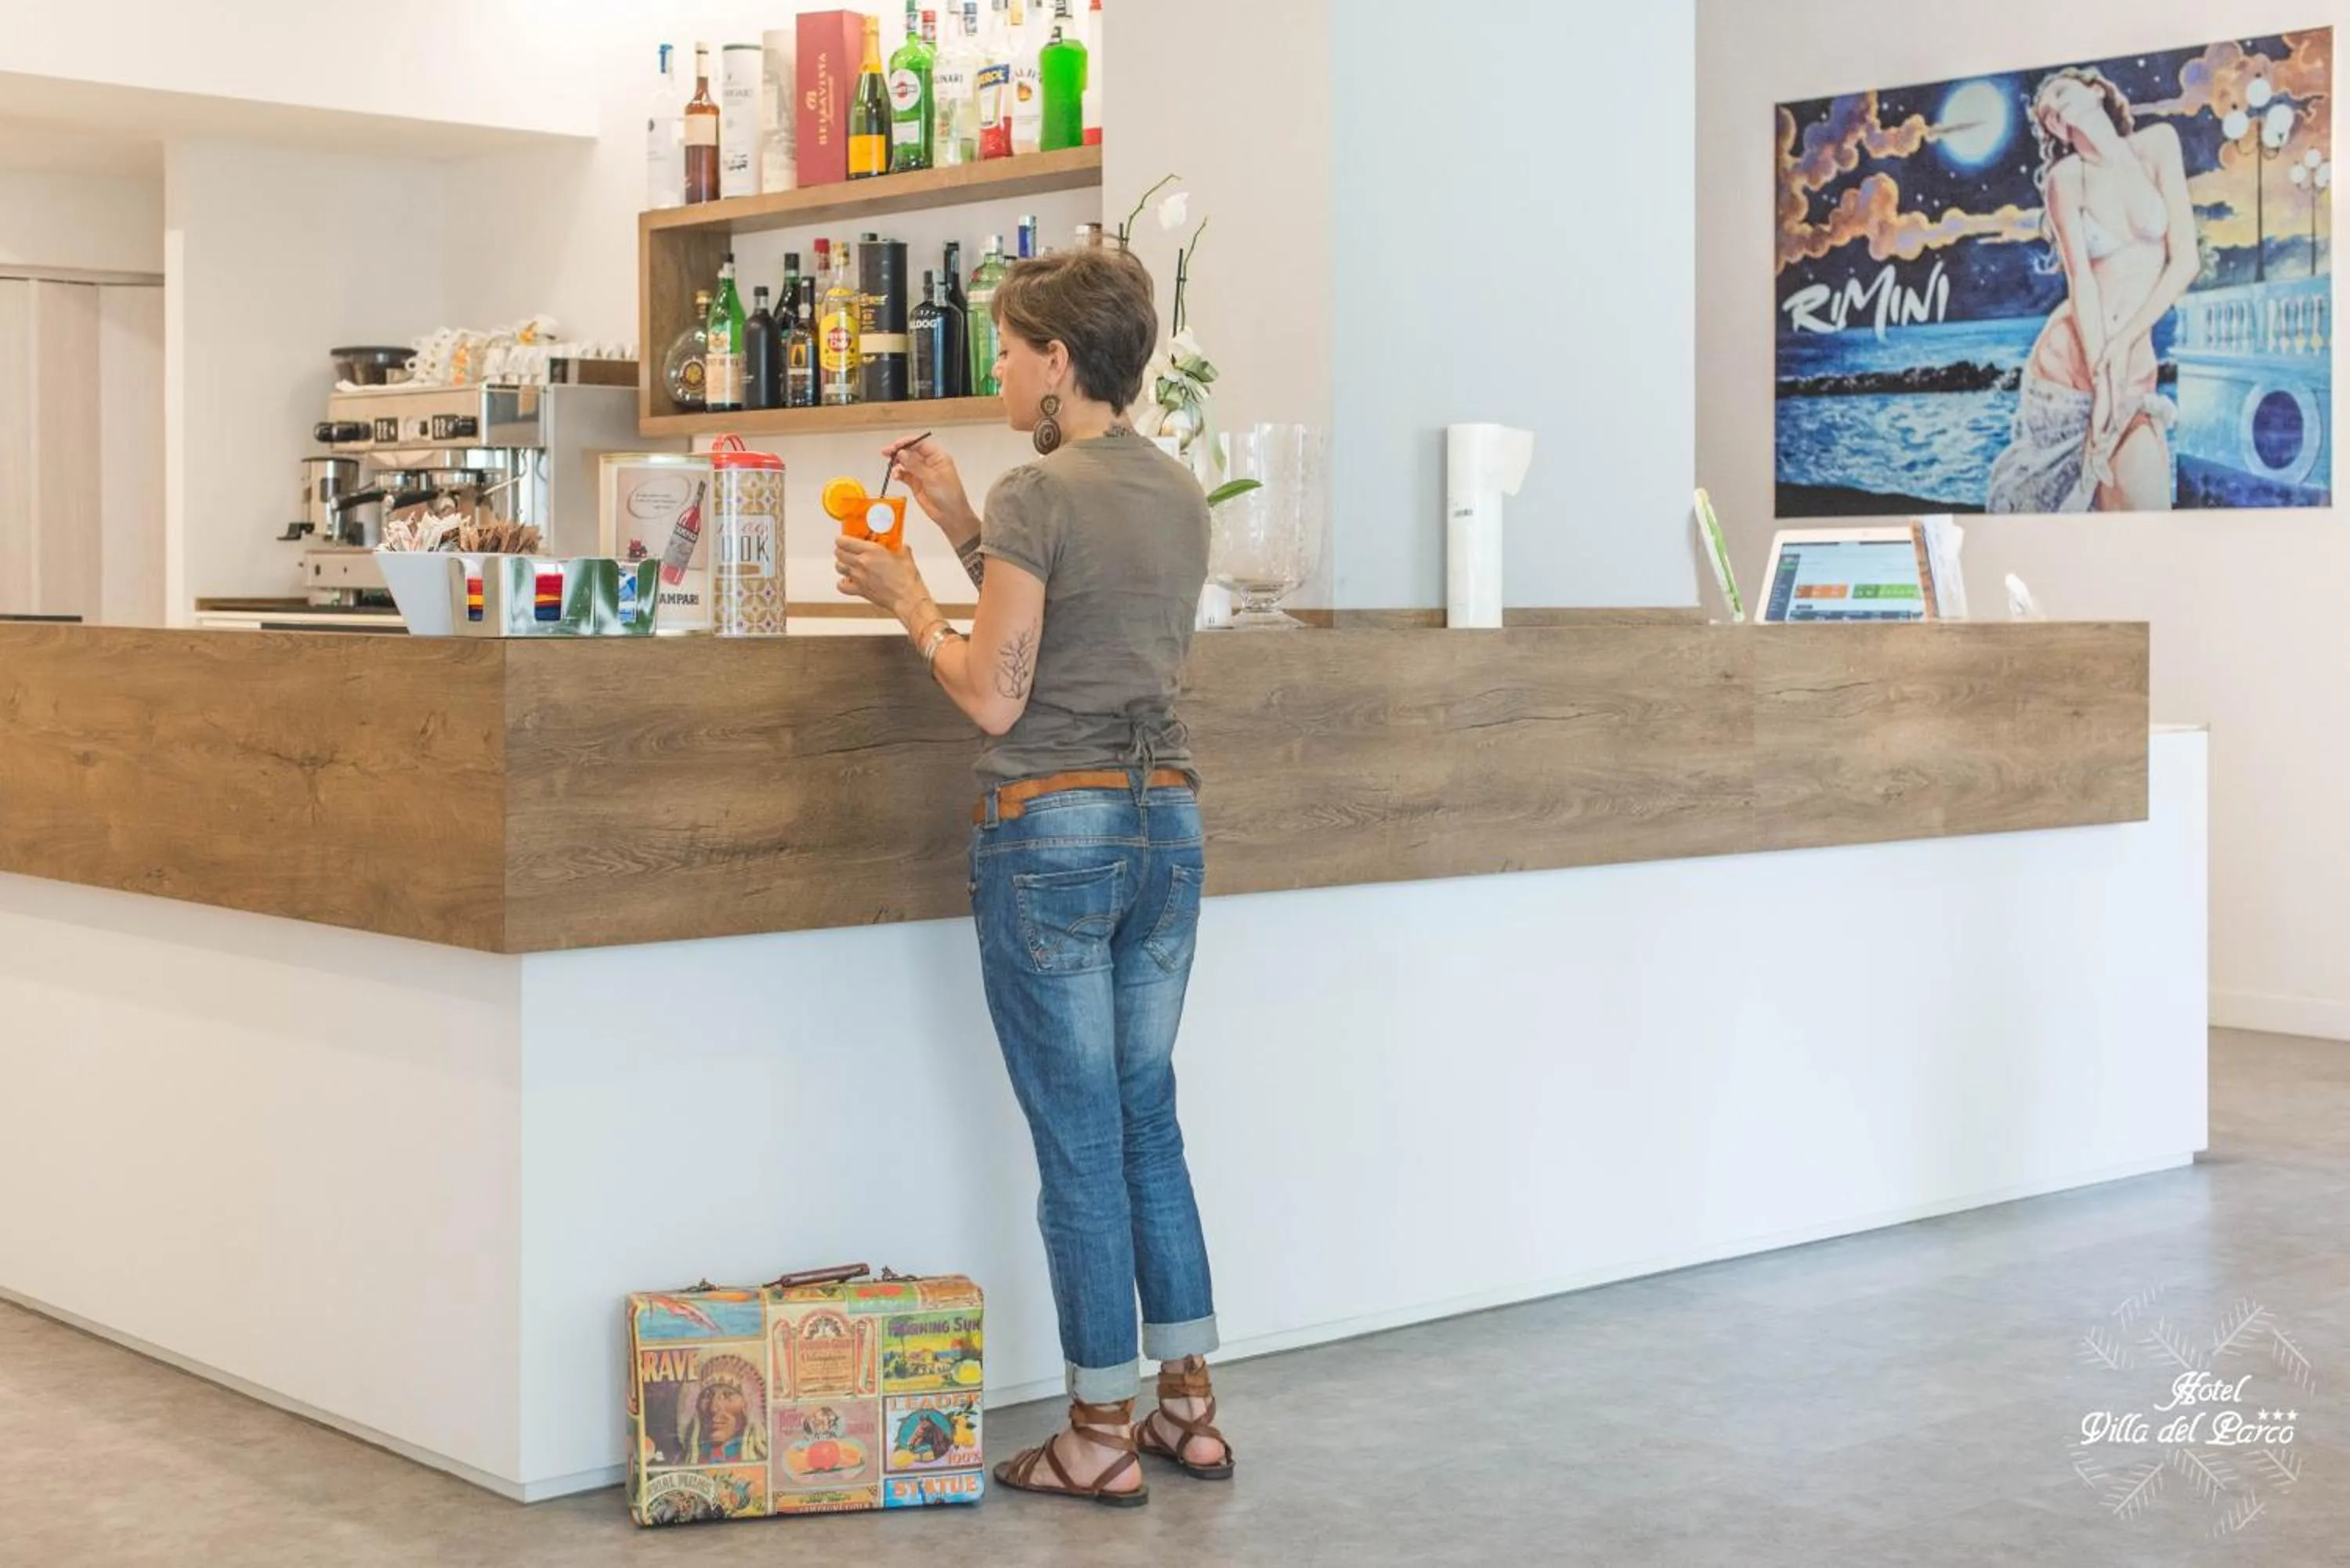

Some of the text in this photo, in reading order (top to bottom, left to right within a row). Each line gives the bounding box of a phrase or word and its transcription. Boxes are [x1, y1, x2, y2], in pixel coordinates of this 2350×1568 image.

[934, 74, 963, 84] LINARI
[818, 51, 831, 146] BELLAVISTA
[1782, 260, 1950, 343] RIMINI
[721, 536, 769, 562] OOK
[659, 593, 700, 605] AMPARI
[640, 1349, 700, 1382] RAVE
